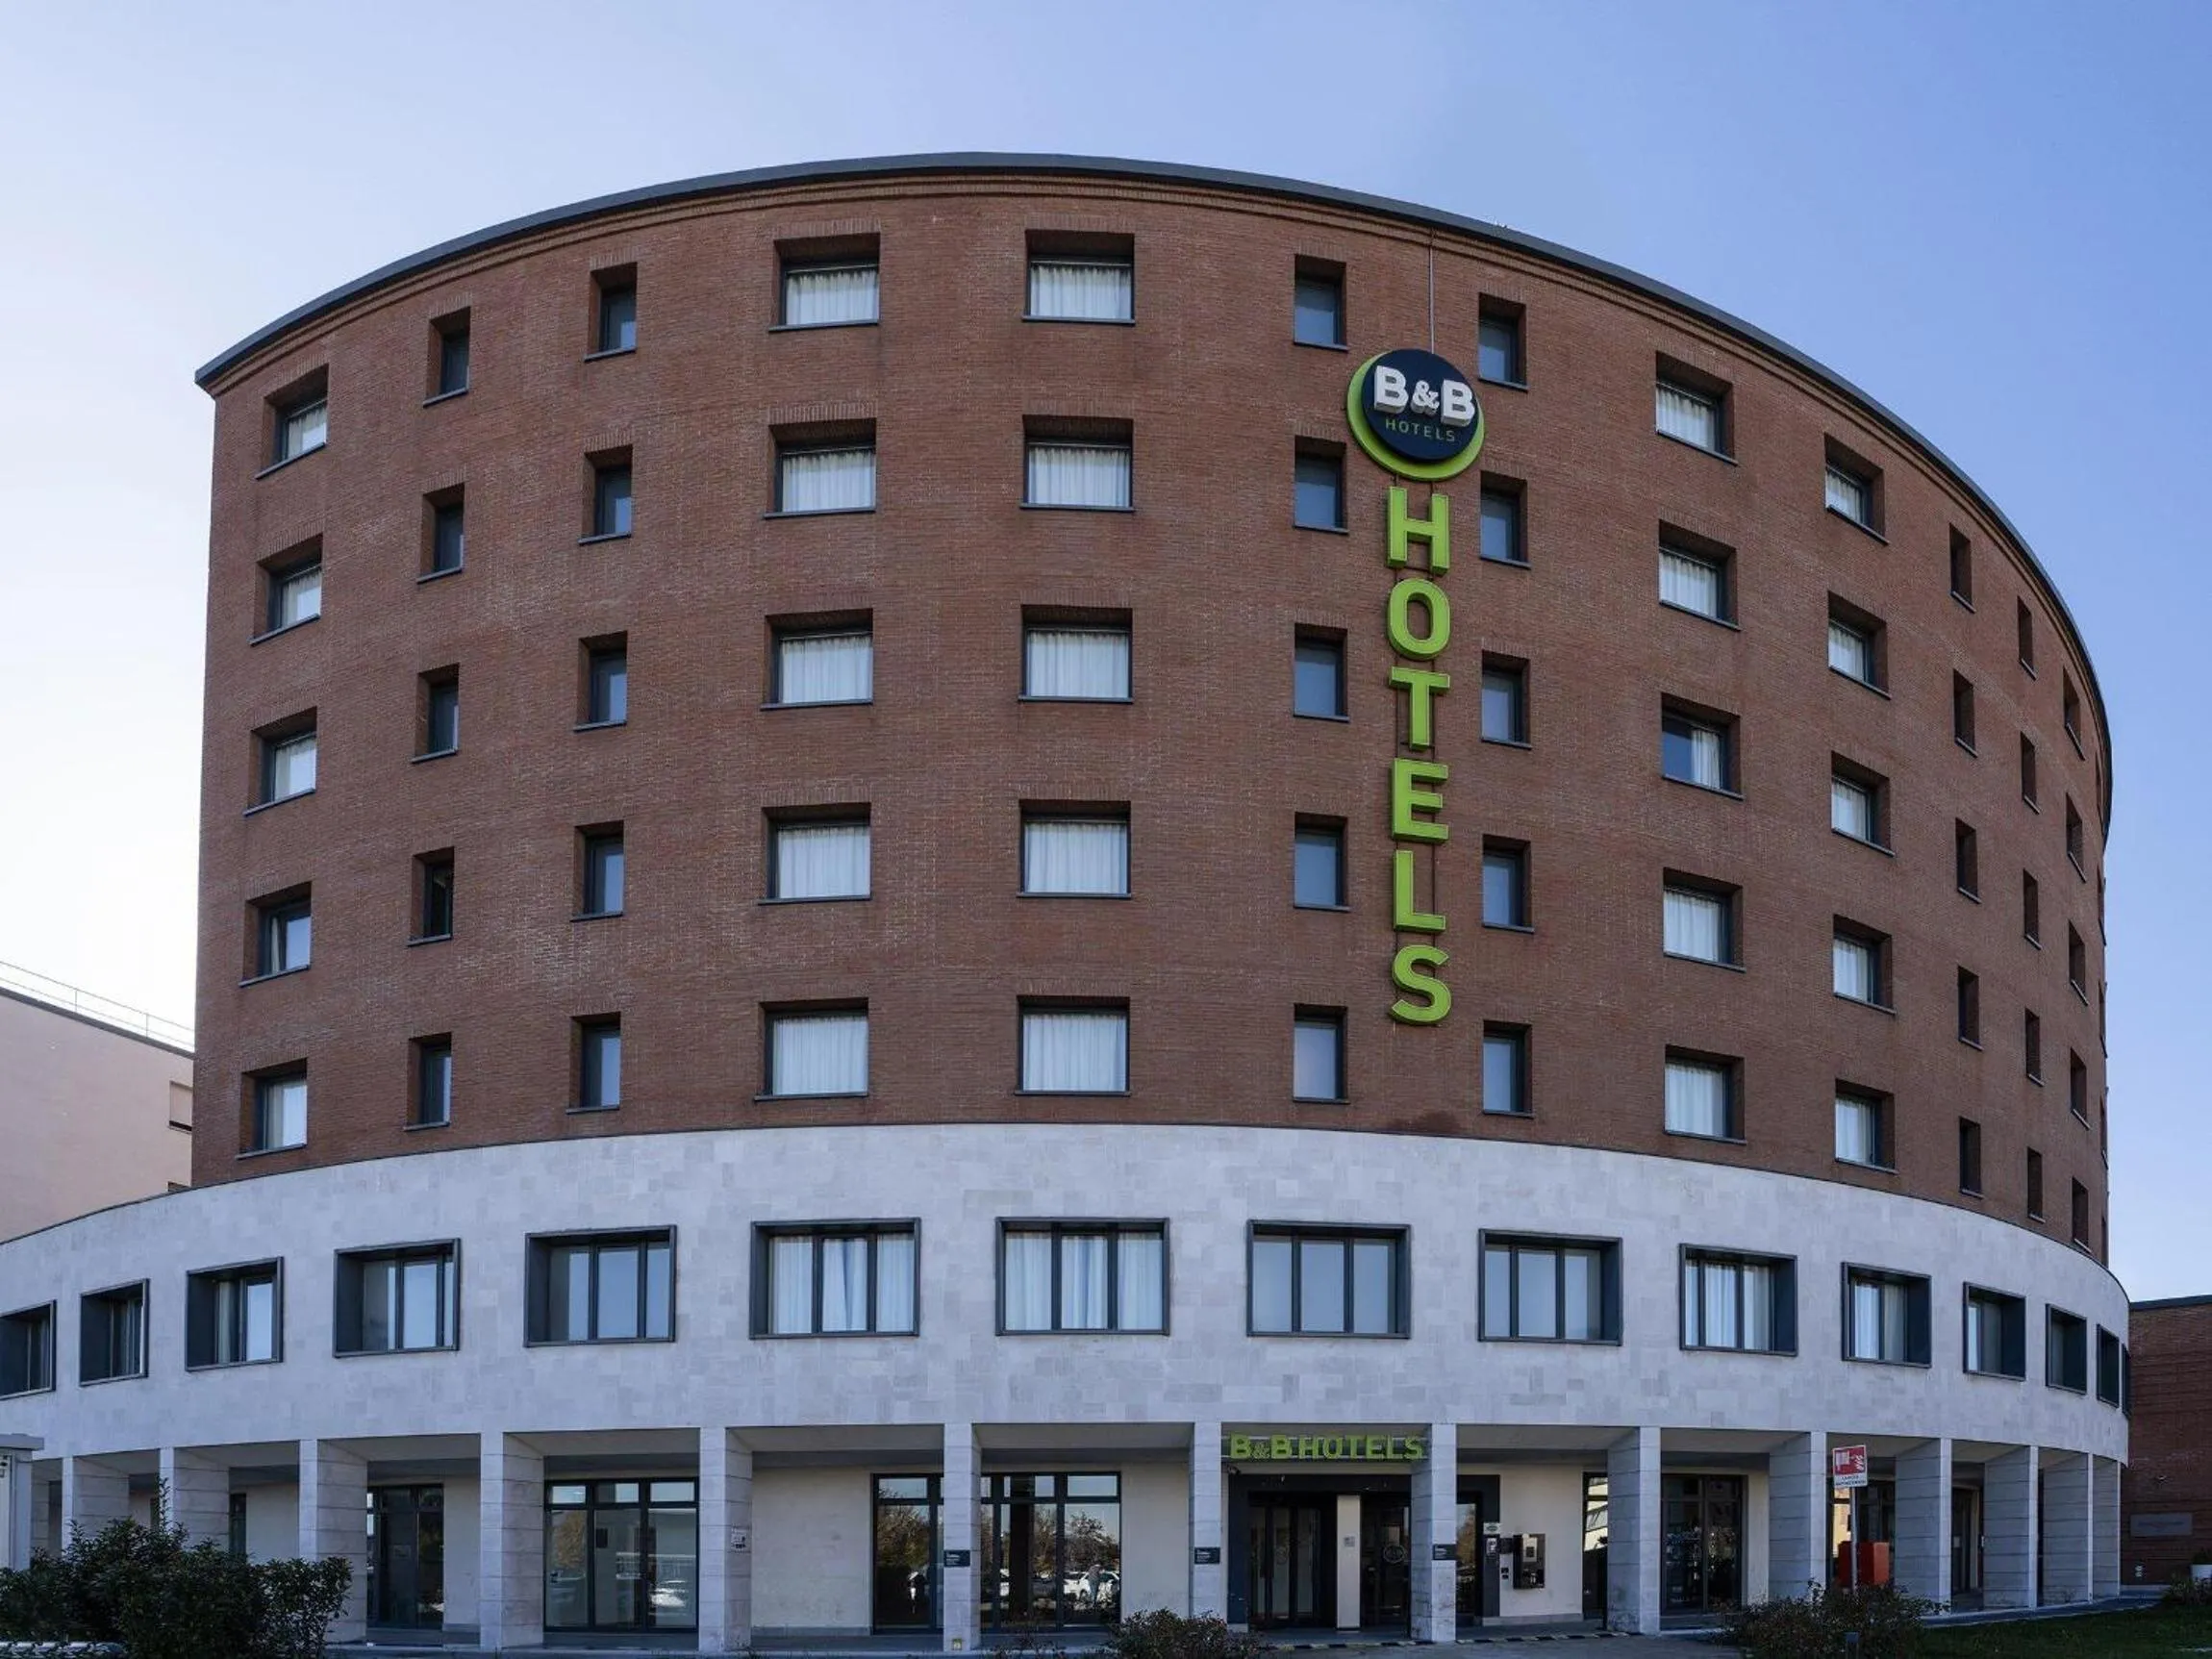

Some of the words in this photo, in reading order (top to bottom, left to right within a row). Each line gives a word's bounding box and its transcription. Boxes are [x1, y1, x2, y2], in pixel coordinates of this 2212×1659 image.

[1374, 365, 1475, 427] B&B
[1385, 418, 1455, 442] HOTELS
[1386, 486, 1452, 1026] HOTELS
[1230, 1433, 1294, 1459] B&B
[1298, 1434, 1423, 1460] HOTELS
